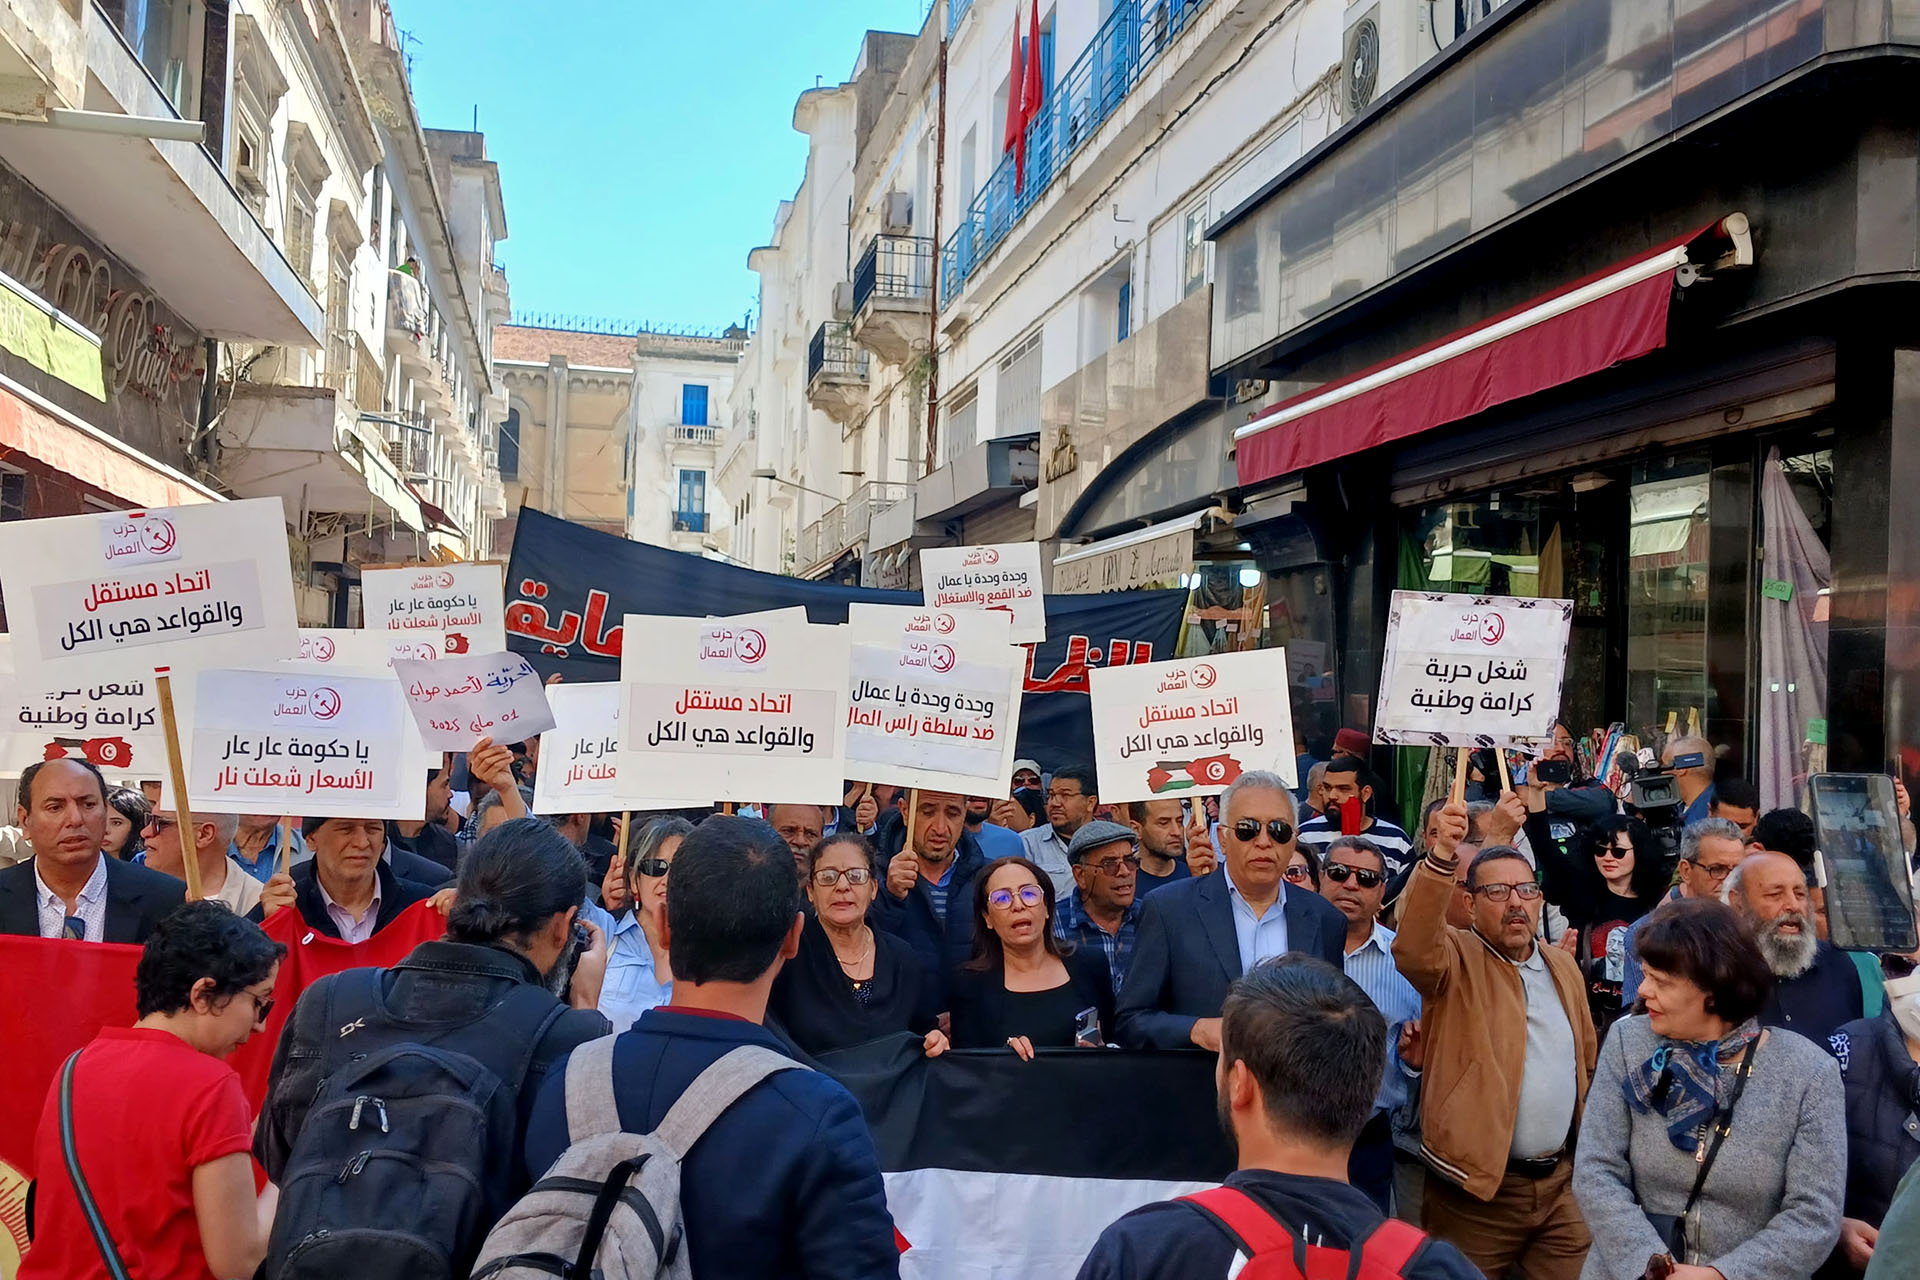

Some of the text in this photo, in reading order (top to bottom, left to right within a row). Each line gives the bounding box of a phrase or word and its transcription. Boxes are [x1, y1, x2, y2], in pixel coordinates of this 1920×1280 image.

[113, 522, 137, 536] حزب
[105, 542, 141, 561] العمال
[961, 558, 983, 567] العمال
[84, 569, 211, 613] اتحاد مستقل
[410, 582, 434, 591] العمال
[937, 570, 1028, 591] وحدة وحدة يا عمال
[388, 593, 478, 616] يا حكومة عار عار
[934, 590, 985, 610] والاستغلال
[987, 588, 1016, 605] القمع
[60, 601, 243, 652] والقواعد هي الكل
[403, 613, 439, 630] شعلت
[441, 612, 483, 630] الأسعار
[904, 622, 932, 633] العمال
[711, 628, 734, 643] حزب
[1450, 628, 1478, 643] العمال
[700, 646, 733, 661] العمال
[899, 655, 928, 668] العمال
[1165, 669, 1188, 681] حزب
[1425, 656, 1529, 686] شغل حرية
[285, 685, 308, 700] حزب
[1157, 679, 1189, 694] العمال
[273, 702, 308, 717] العمال
[674, 688, 792, 715] اتحاد مستقل
[851, 680, 995, 720] وحدة وحدة يا عمال
[1410, 687, 1535, 718] كرامة وطنية
[19, 705, 156, 731] كرامة وطنية
[1138, 696, 1239, 729] اتحاد مستقل
[884, 712, 919, 737] راس
[921, 716, 969, 739] سلطة
[647, 720, 815, 754] والقواعد هي الكل
[1120, 723, 1264, 760] والقواعد هي الكل
[222, 733, 370, 764] يا حكومة عار عار
[571, 738, 594, 760] عار
[214, 764, 374, 795] الأسعار شعلت نار
[565, 763, 617, 786] علت نار
